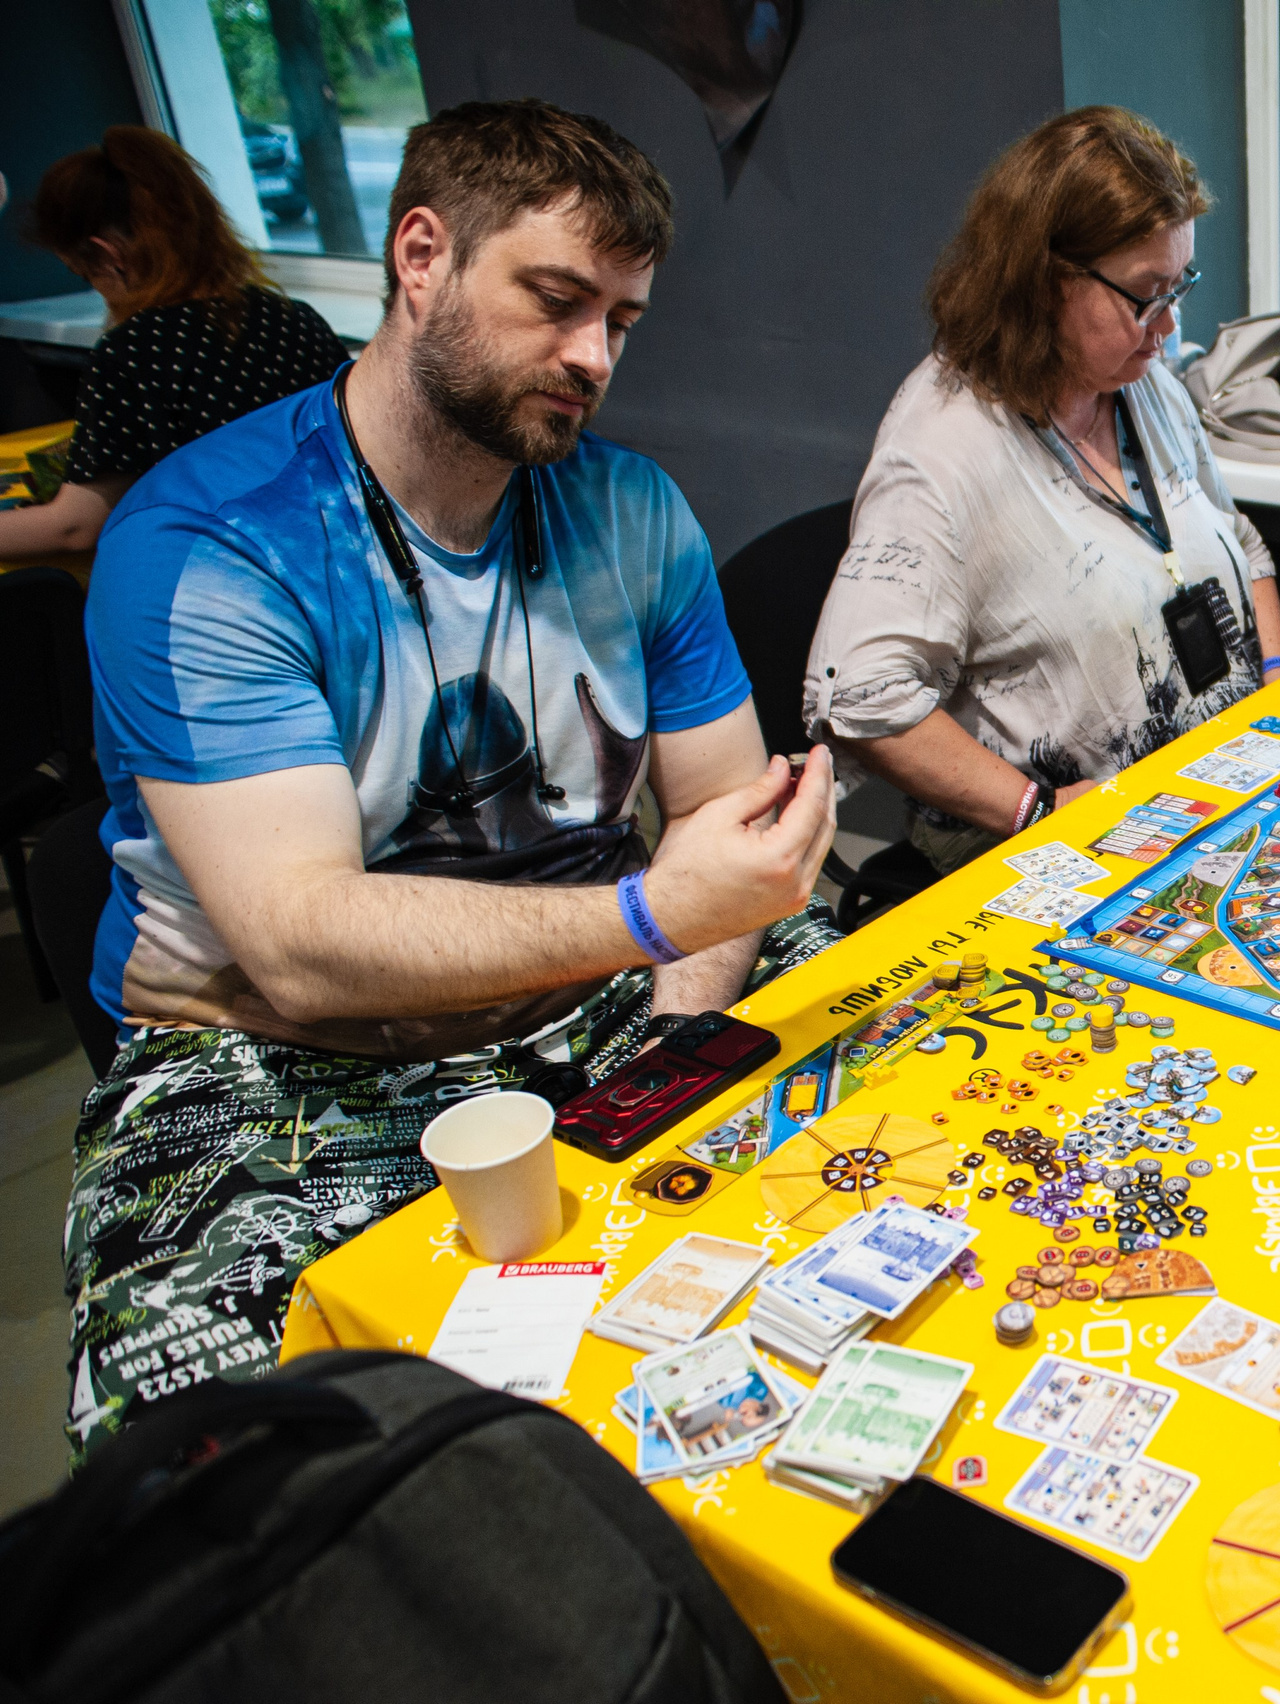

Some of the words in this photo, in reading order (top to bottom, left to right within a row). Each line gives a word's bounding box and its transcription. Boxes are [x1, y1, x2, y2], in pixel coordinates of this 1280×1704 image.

[625, 884, 654, 941] ФЕСТИВАЛЬ
[927, 931, 972, 955] ТЫ
[828, 955, 928, 1017] ЛЮБИШЬ
[238, 1120, 311, 1136] OCEAN
[371, 1163, 431, 1174] SAILING
[520, 1262, 593, 1275] BRAUBERG
[215, 1294, 239, 1314] J.
[98, 1303, 214, 1368] SKIPPERS
[166, 1315, 254, 1362] RULES
[118, 1349, 165, 1381] FOR
[216, 1336, 270, 1371] KEY
[137, 1358, 214, 1402] XS23
